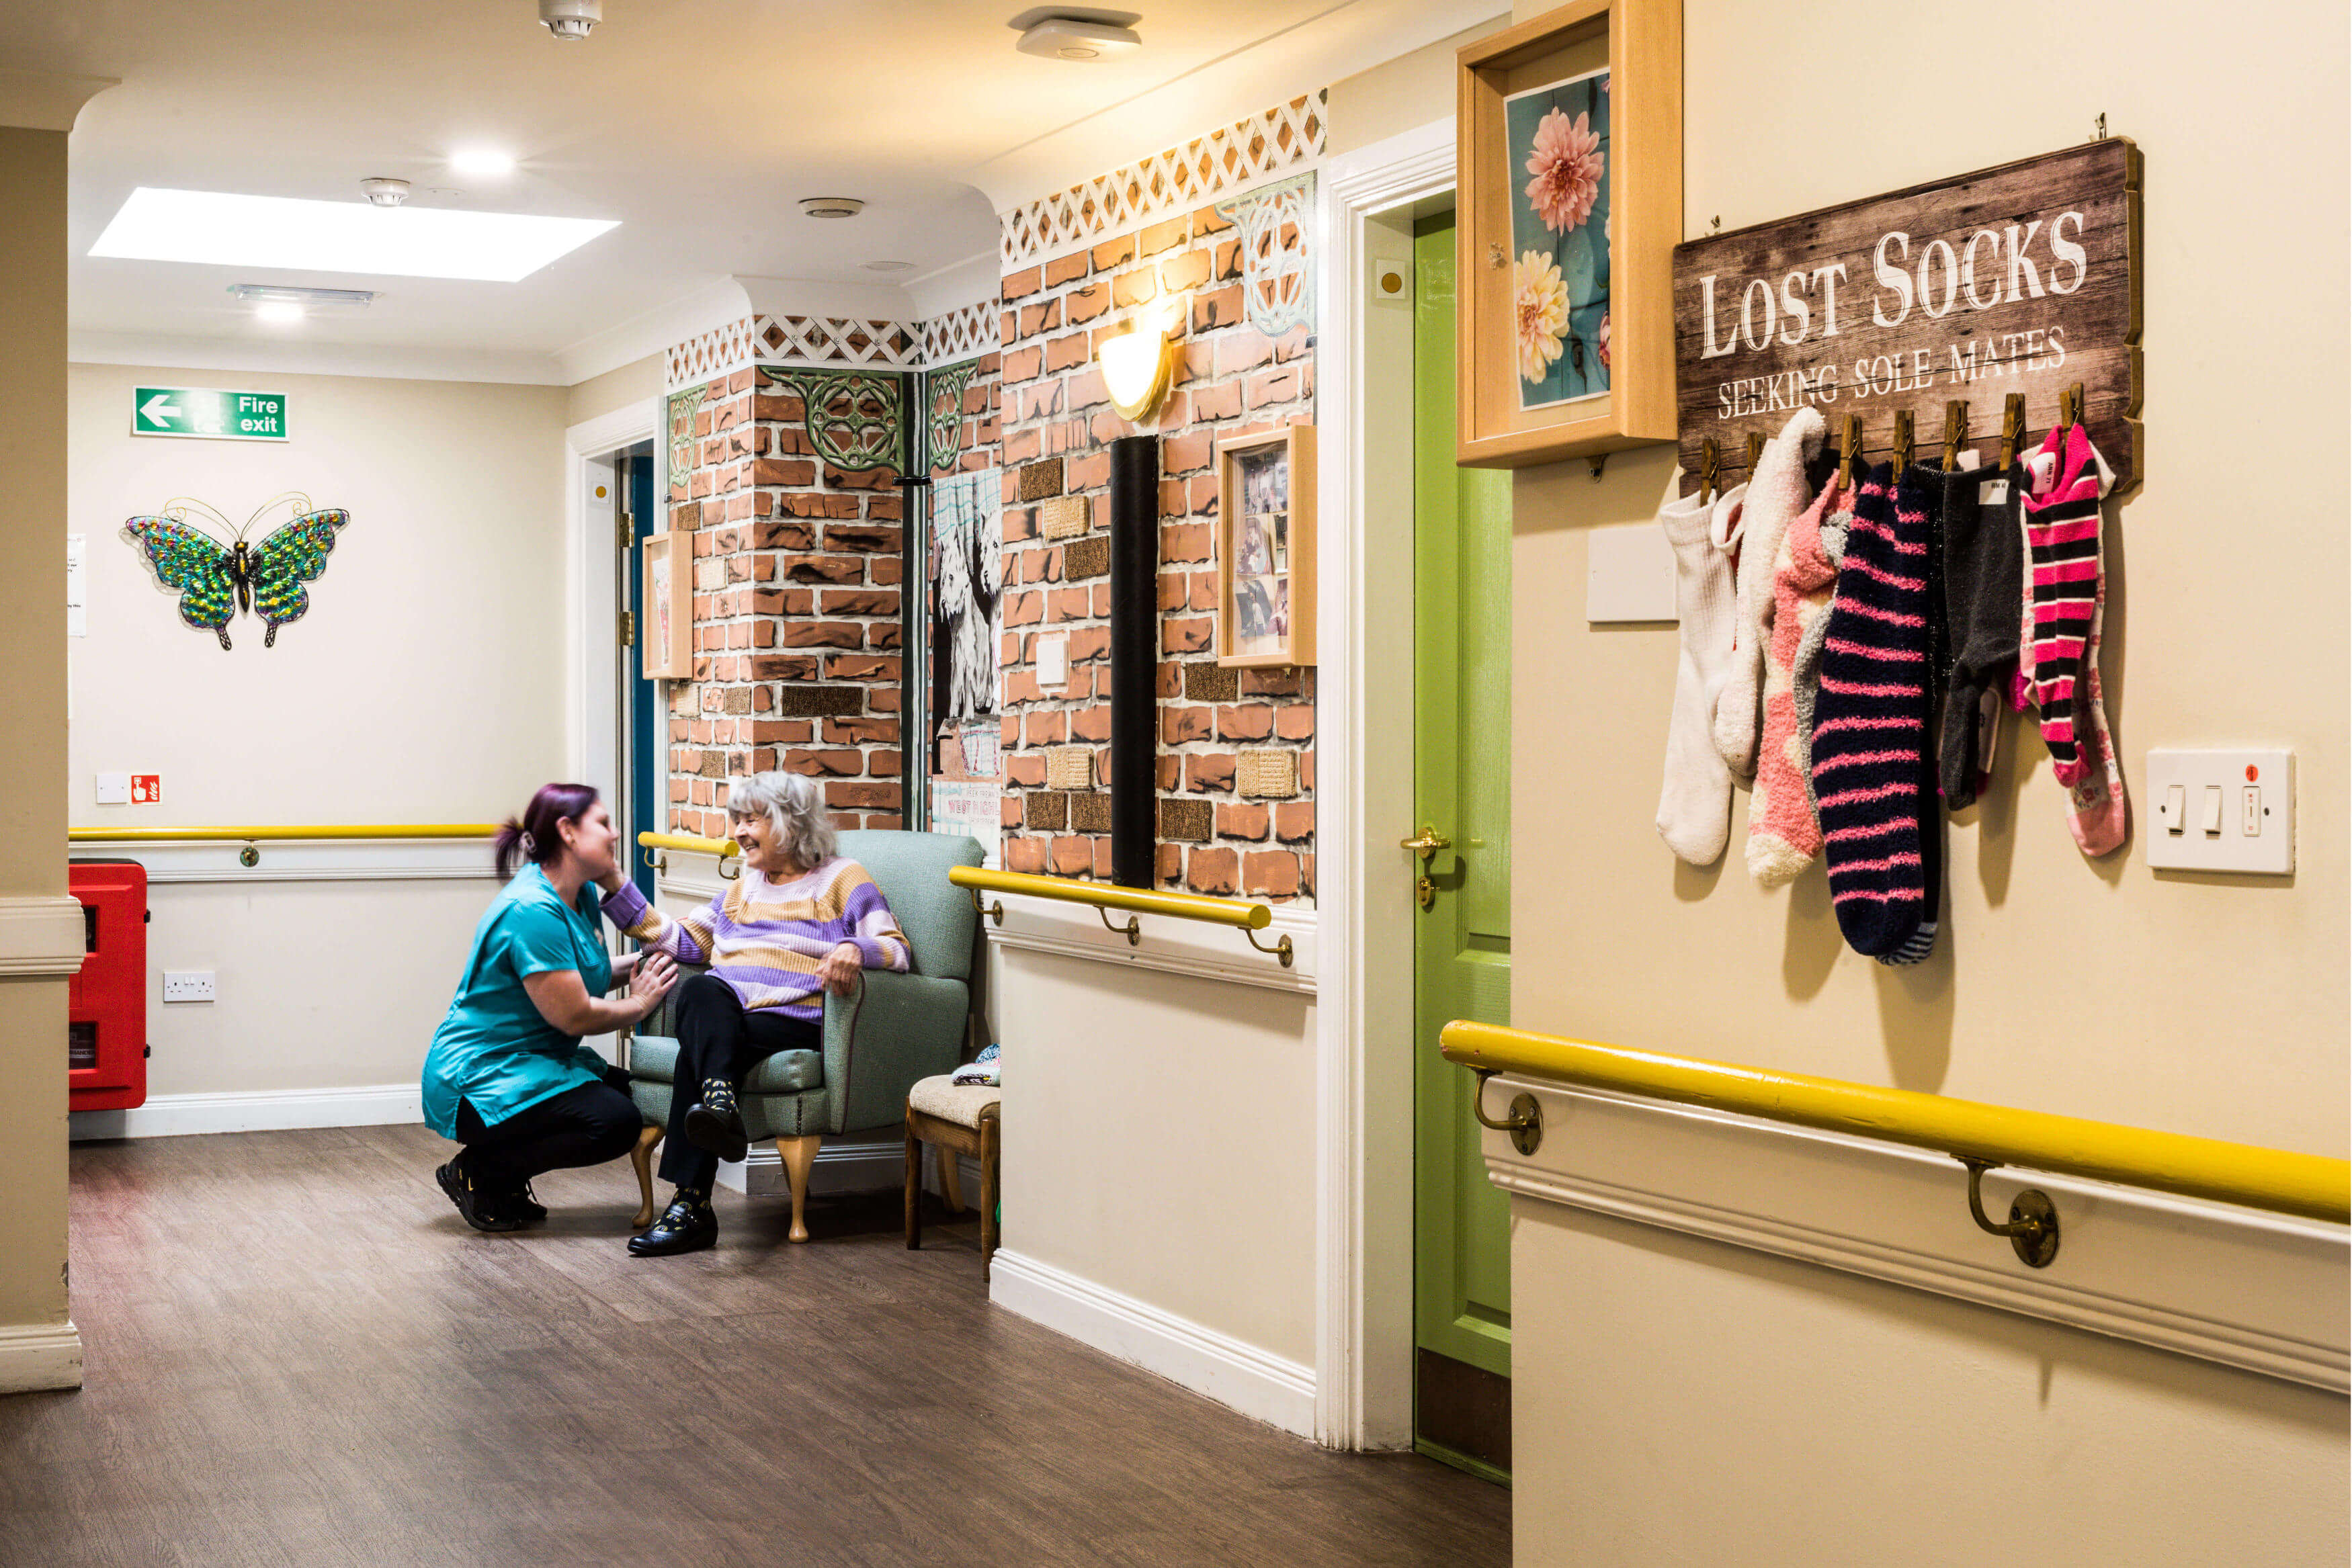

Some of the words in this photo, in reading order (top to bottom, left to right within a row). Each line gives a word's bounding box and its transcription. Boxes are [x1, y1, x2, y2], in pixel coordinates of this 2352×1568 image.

[1699, 263, 1847, 360] LOST
[1872, 211, 2087, 328] SOCKS
[1717, 364, 1839, 420] SEEKING
[1854, 348, 1933, 398] SOLE
[1948, 325, 2066, 384] MATES
[239, 396, 278, 414] Fire
[240, 417, 278, 433] exit
